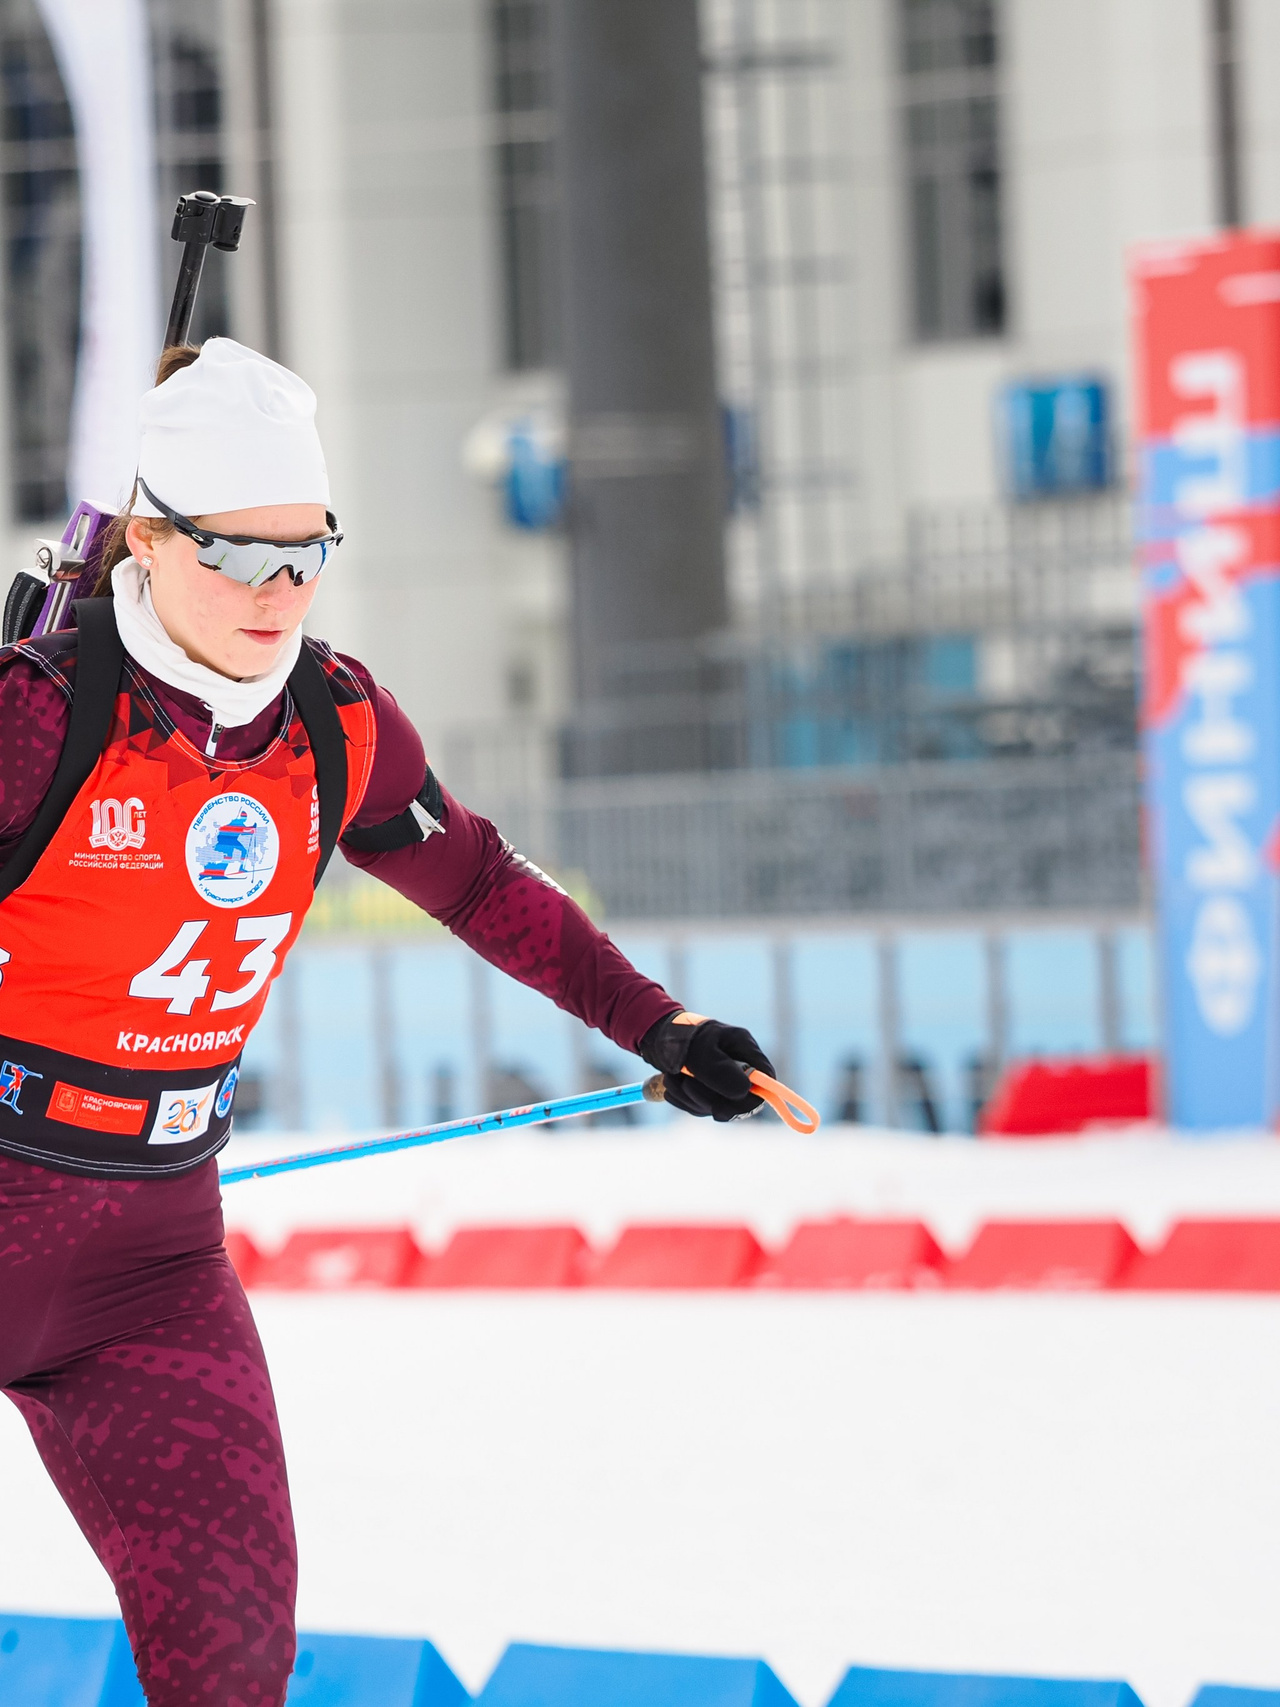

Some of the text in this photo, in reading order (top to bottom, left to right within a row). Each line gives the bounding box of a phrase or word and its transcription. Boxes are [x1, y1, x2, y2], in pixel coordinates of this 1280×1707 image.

[1170, 350, 1261, 1037] ФИНИШ
[133, 811, 147, 819] ЛЕТ
[192, 795, 270, 831] ПЕРВЕНСТВО РОССИИ
[68, 860, 164, 870] РОССИЙСКОЙ ФЕДЕРАЦИИ
[74, 852, 161, 861] МИНИСТЕРСТВО СПОРТА
[127, 911, 293, 1016] 43
[116, 1024, 246, 1054] КРАСНОЯРСК
[81, 1102, 102, 1112] КРАЙ
[83, 1094, 143, 1111] КРАСНОЯРСКИЙ
